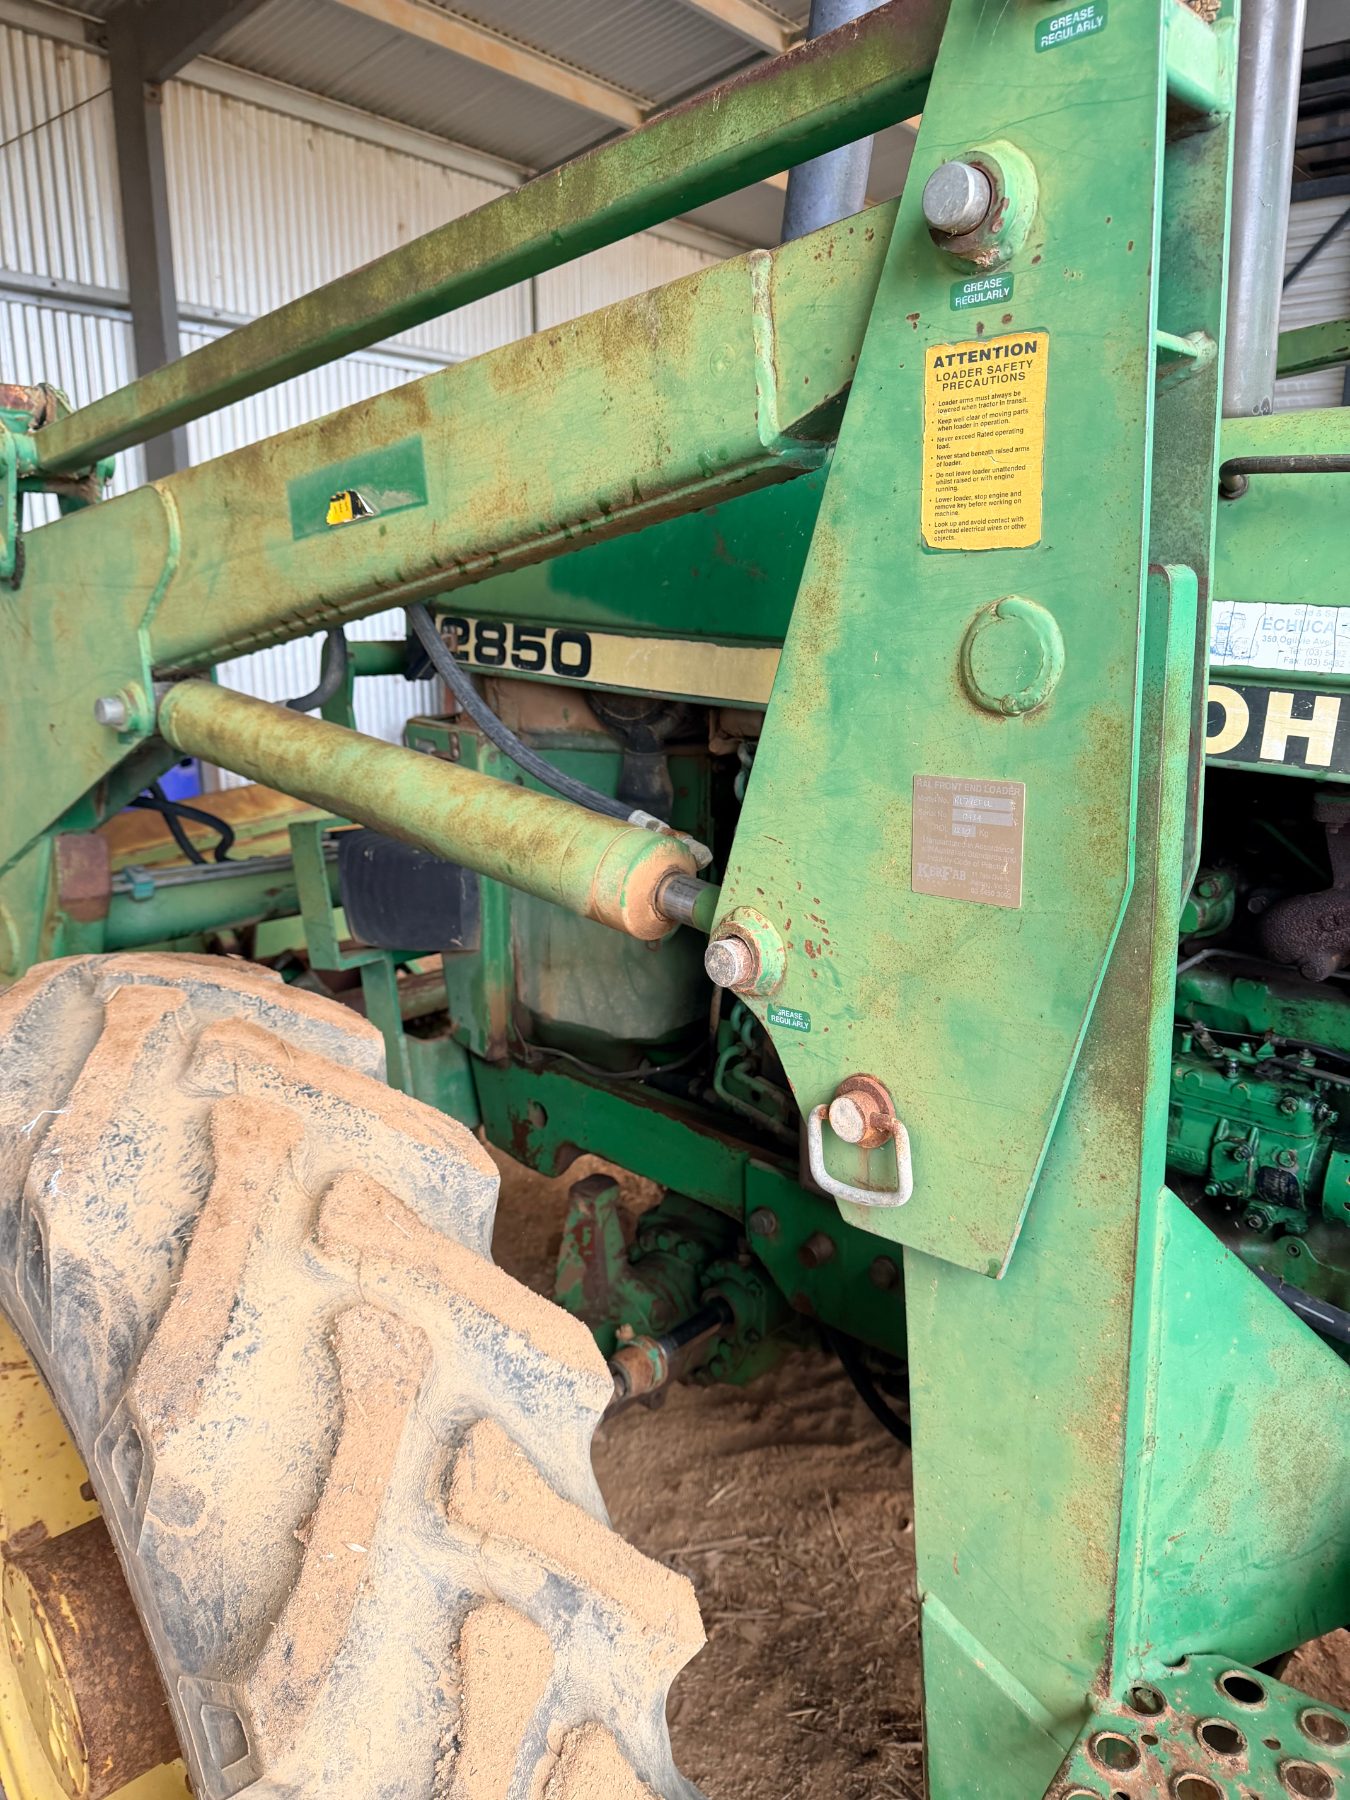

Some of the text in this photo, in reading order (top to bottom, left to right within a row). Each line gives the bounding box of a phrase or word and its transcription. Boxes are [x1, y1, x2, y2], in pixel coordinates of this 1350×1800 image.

[1050, 6, 1094, 31] GREASE
[1041, 16, 1103, 47] REGULARLY
[964, 278, 1002, 293] GREASE
[955, 287, 1009, 308] REGULARLY
[933, 340, 1037, 368] ATTENTION
[936, 360, 1033, 382] LOADER SAFETY
[942, 372, 1026, 391] PRECAUTIONS
[938, 397, 958, 406] Loader
[991, 392, 1012, 401] always
[979, 401, 998, 409] tractor
[989, 410, 1011, 418] moving
[1013, 408, 1028, 416] parts
[937, 424, 952, 432] when
[954, 432, 975, 441] exceed
[977, 430, 993, 438] Rated
[995, 428, 1024, 437] operating
[971, 449, 994, 457] beneath
[956, 469, 971, 477] leave
[992, 465, 1026, 473] unattended
[954, 476, 971, 484] raised
[994, 473, 1014, 481] engine
[975, 493, 987, 501] stop
[989, 491, 1008, 500] engine
[957, 501, 967, 510] key
[971, 517, 986, 525] avoid
[934, 527, 959, 535] overhead
[960, 525, 986, 533] electrical
[1262, 618, 1334, 633] ECHUCA
[441, 616, 592, 678] 2850
[1306, 648, 1322, 656] (03)
[1304, 658, 1320, 666] (03)
[964, 784, 982, 793] END
[985, 785, 1020, 796] LOADER
[778, 1009, 803, 1020] GREASE
[771, 1015, 809, 1029] REGULARLY
